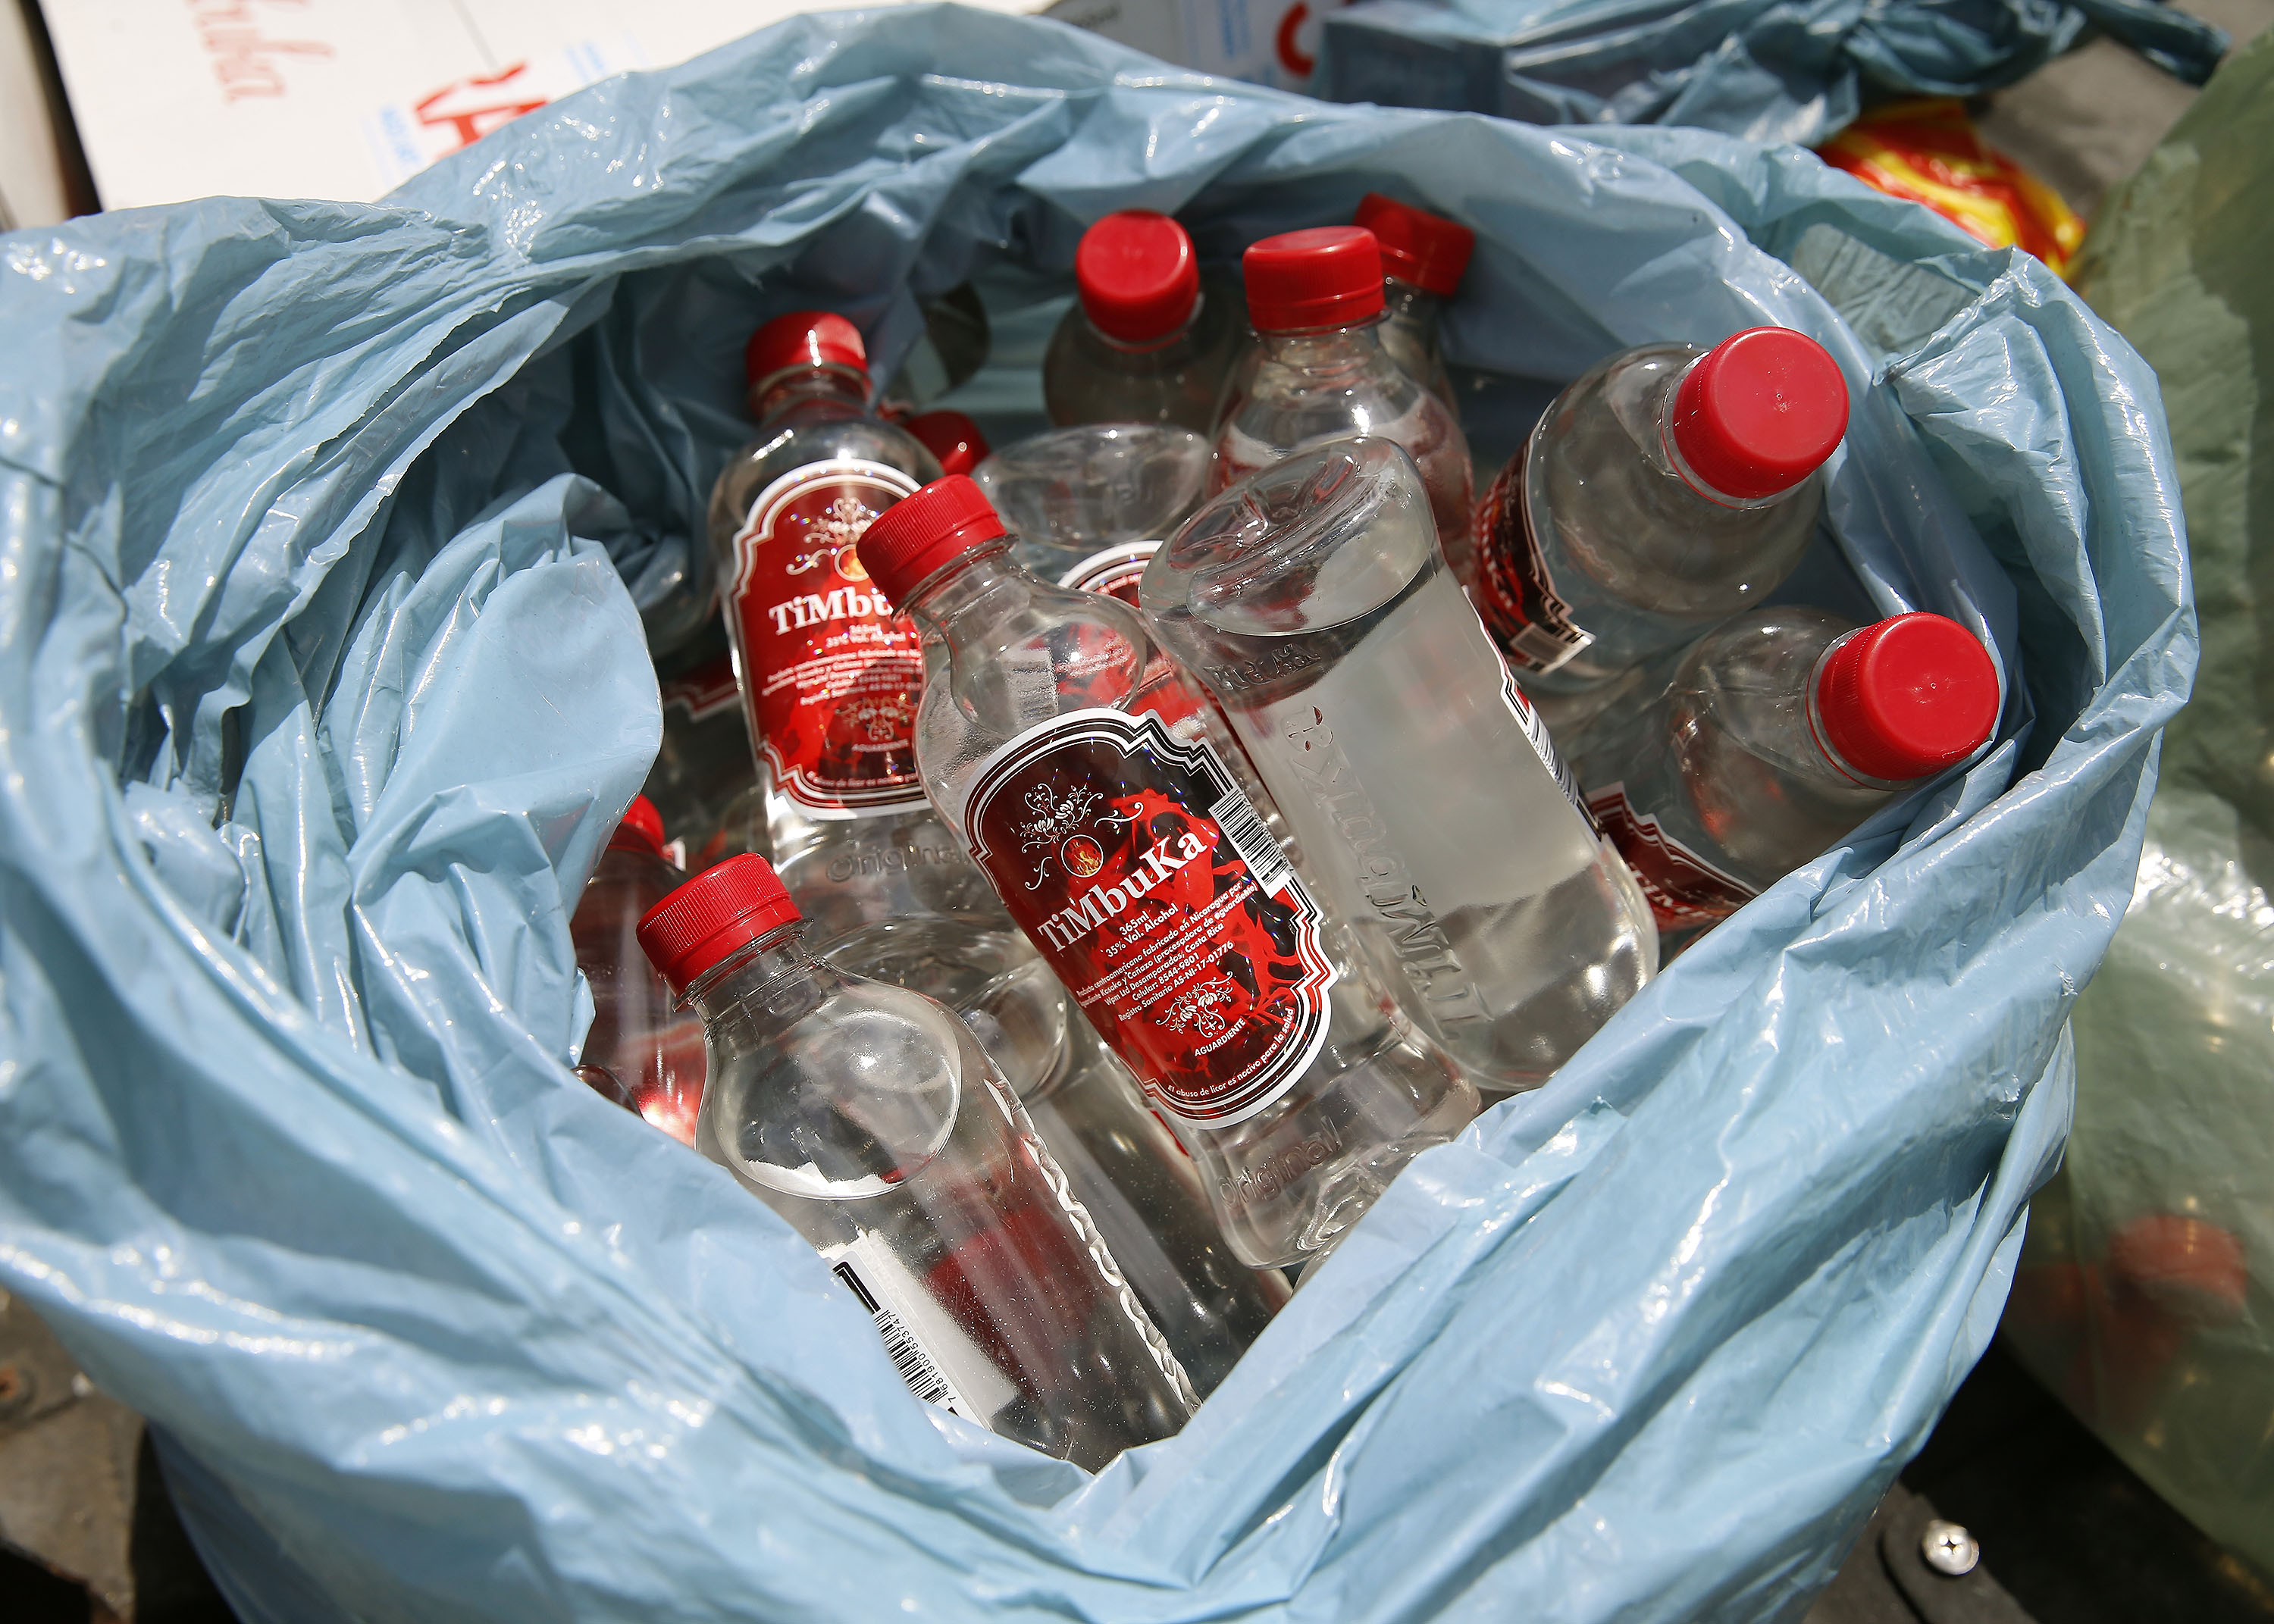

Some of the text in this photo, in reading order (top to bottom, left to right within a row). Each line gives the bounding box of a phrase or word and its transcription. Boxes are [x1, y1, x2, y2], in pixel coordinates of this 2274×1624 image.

[1037, 832, 1207, 952] TiMbuKa
[1119, 910, 1150, 936] 365ml
[1094, 954, 1143, 988] centroamericano
[1142, 929, 1179, 956] fabricado
[1179, 922, 1190, 931] en
[1189, 892, 1229, 924] Nicaragua
[1228, 881, 1242, 897] por
[1100, 981, 1122, 997] Kosako
[1127, 960, 1154, 980] Cañazo
[1153, 925, 1203, 964] (procesadora
[1203, 918, 1214, 928] de
[1214, 881, 1258, 920] aguardiente)
[1104, 993, 1121, 1006] Wpm
[1120, 986, 1131, 997] Ltd
[1185, 935, 1207, 953] Costa
[1206, 923, 1224, 938] Rica
[1105, 903, 1179, 958] 35% Vol. Alcohol
[1118, 940, 1234, 1022] Registro Sanitario AS-NI-17-01776
[1132, 952, 1200, 1001] Celular: 8544-9801
[1176, 1089, 1198, 1097] abuso
[1200, 1087, 1210, 1096] de
[1210, 1083, 1226, 1094] licor
[1227, 1077, 1237, 1086] es
[1237, 1060, 1261, 1081] nocivo
[1260, 1042, 1278, 1064] para
[1273, 1034, 1285, 1044] la
[1282, 1007, 1295, 1034] salud
[1194, 1018, 1247, 1056] AGUARDIENTE
[888, 1313, 919, 1350] 553747
[918, 1353, 948, 1391] 681900
